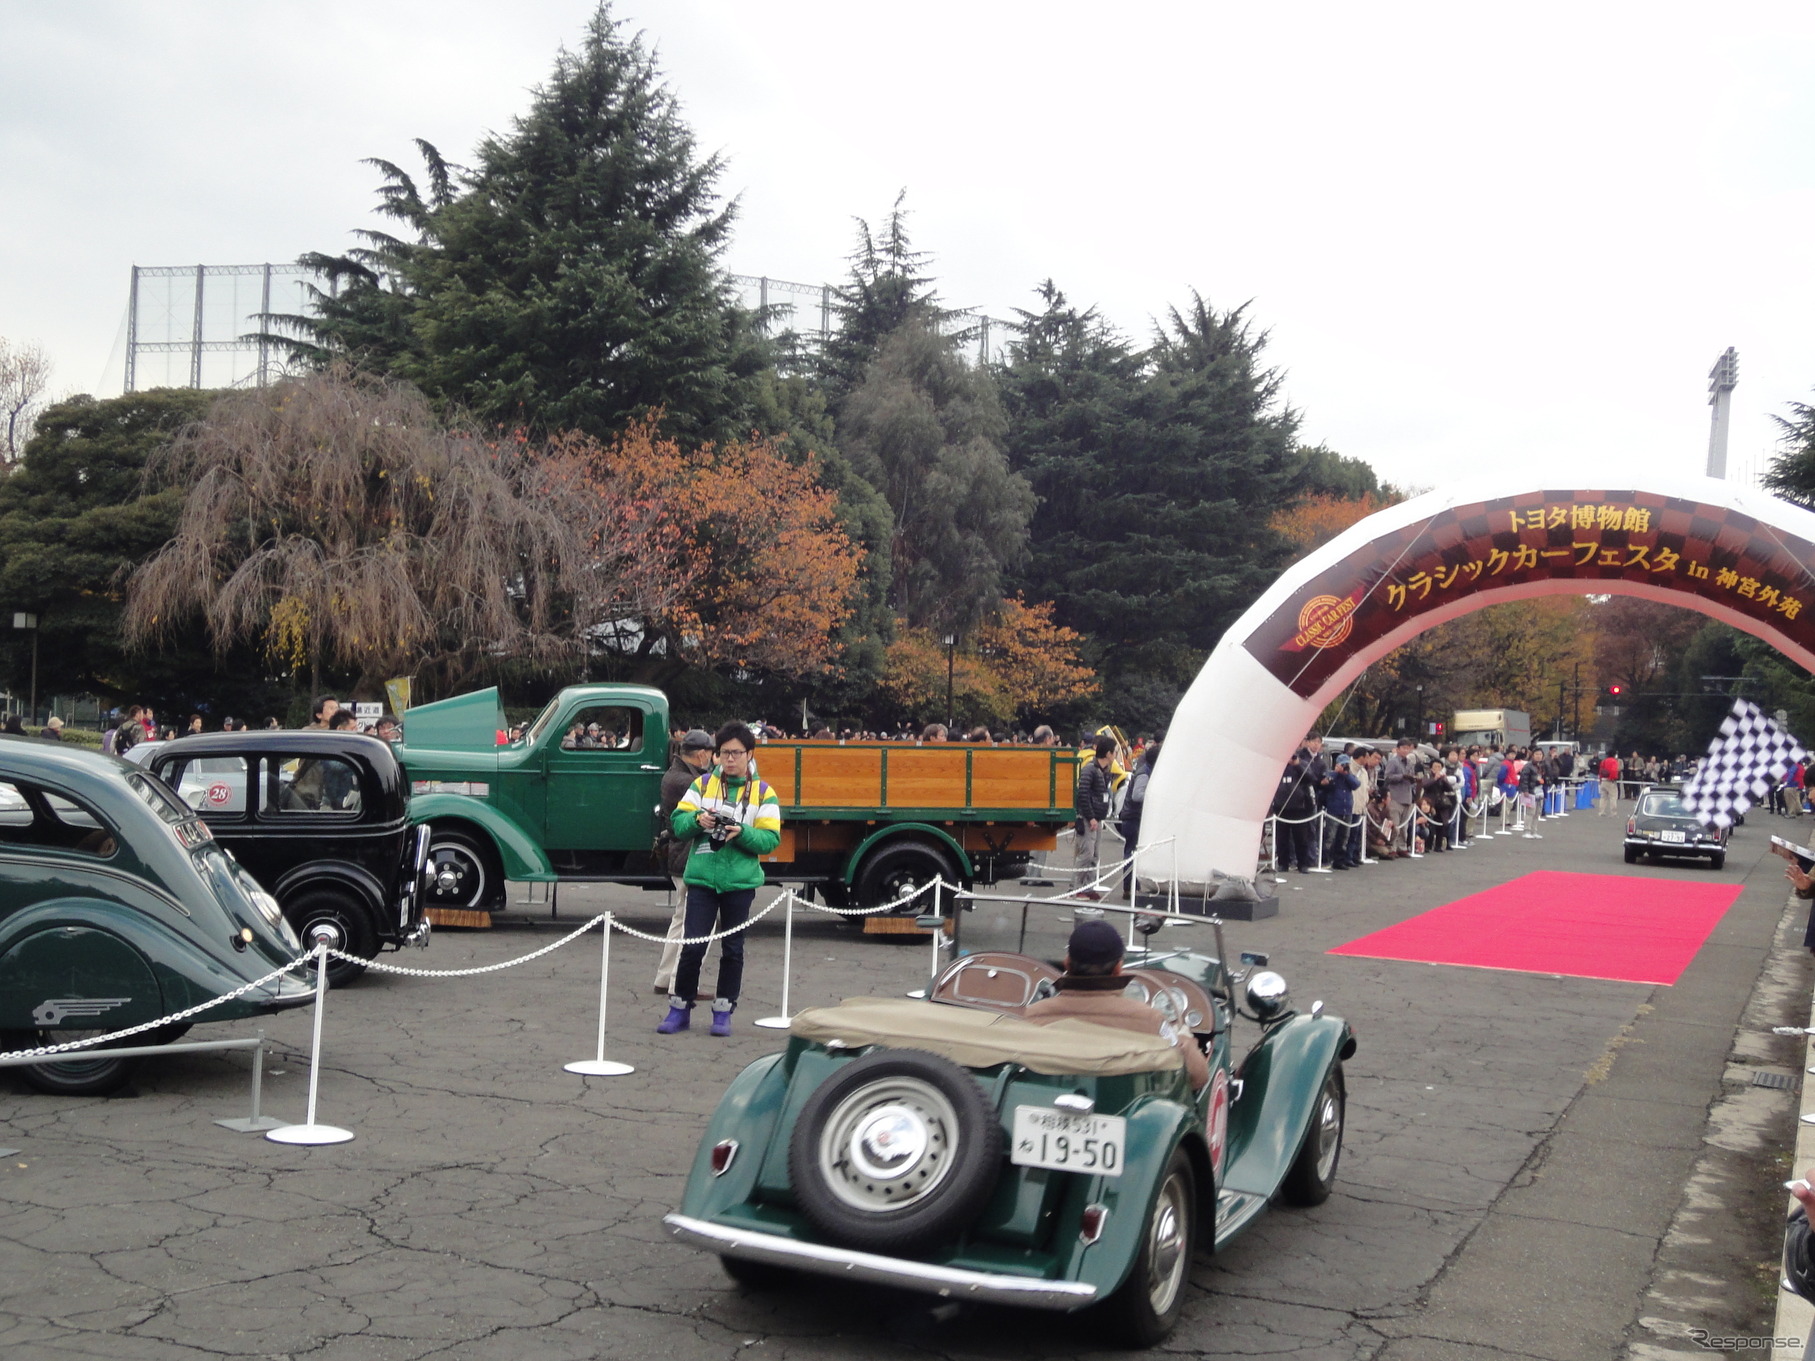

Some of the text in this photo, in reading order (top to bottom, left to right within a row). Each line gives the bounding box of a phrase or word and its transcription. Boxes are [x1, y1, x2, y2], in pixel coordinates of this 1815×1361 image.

[1508, 504, 1652, 533] トヨタ博物館
[1387, 541, 1803, 621] クラシックカーフェスタ in 神宮外苑
[1295, 620, 1326, 647] CLASSIC
[1322, 608, 1340, 627] CAR
[1335, 596, 1356, 616] FEST
[211, 788, 227, 800] 28
[1040, 1133, 1117, 1169] 19-50
